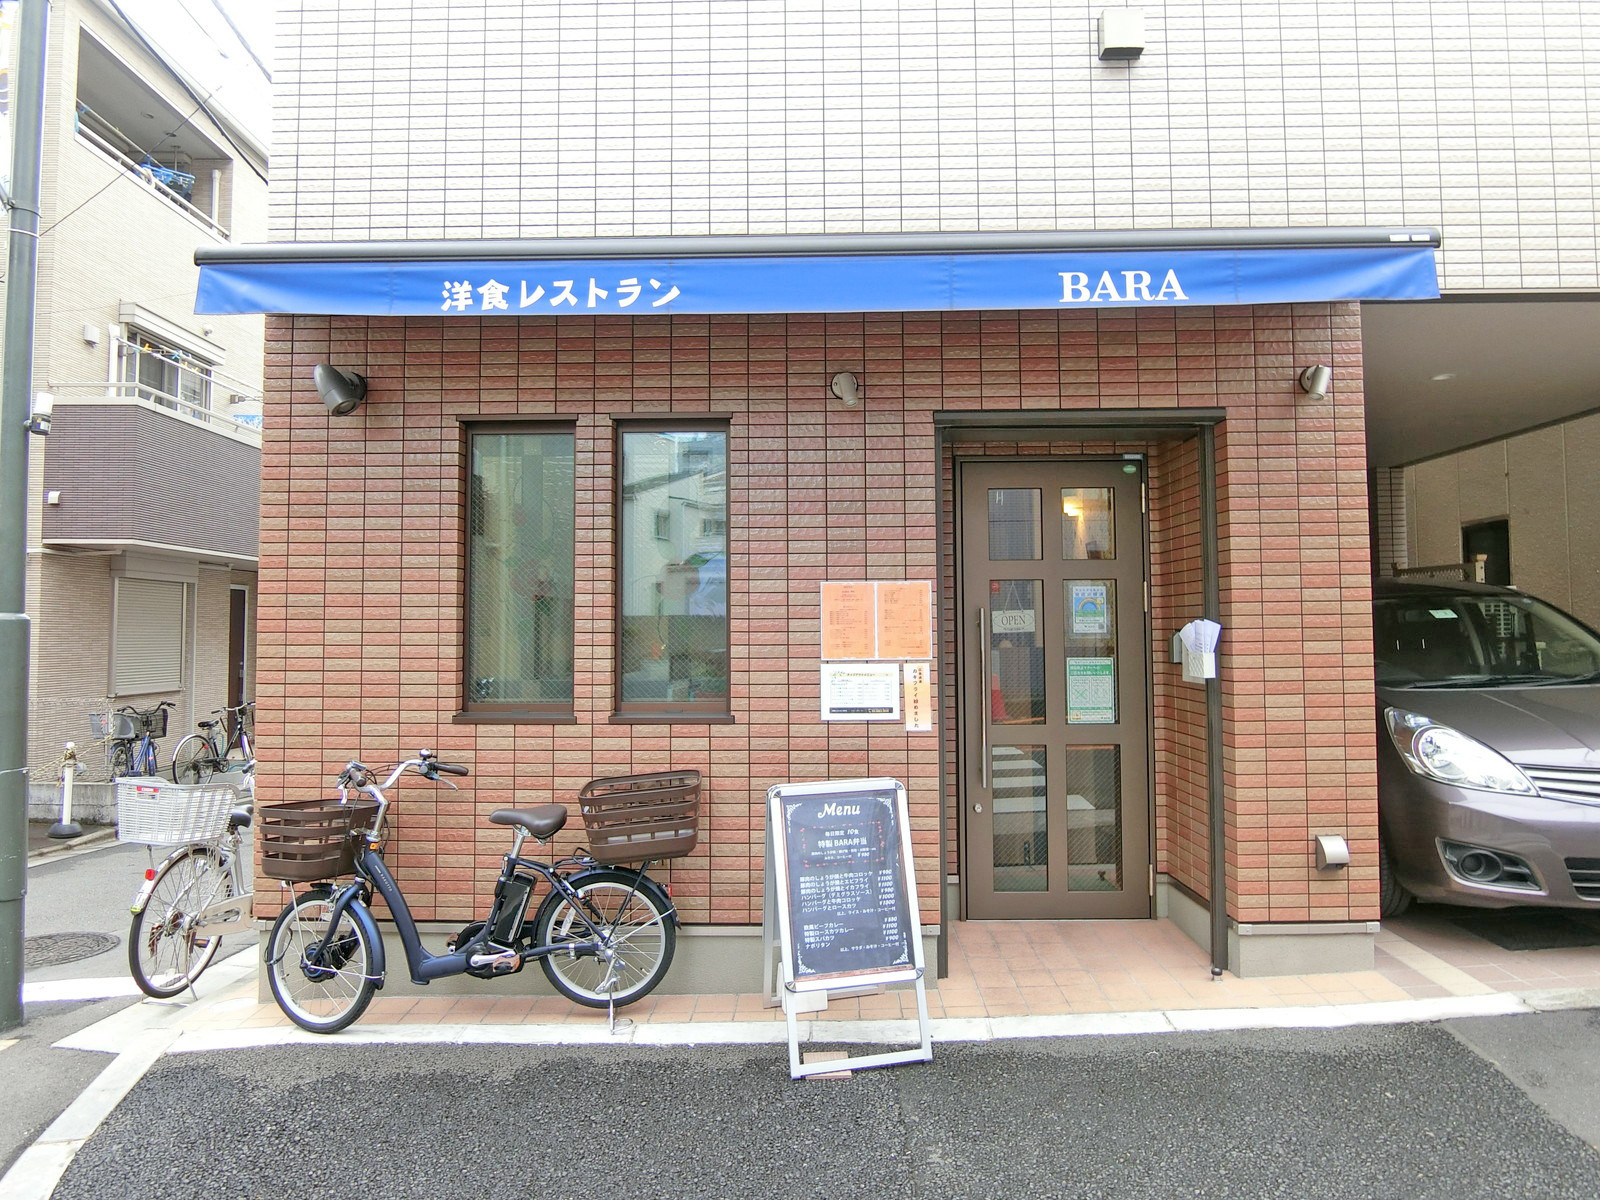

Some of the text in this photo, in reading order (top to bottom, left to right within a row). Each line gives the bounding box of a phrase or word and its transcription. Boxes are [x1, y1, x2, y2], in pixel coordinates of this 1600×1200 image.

[1058, 269, 1189, 302] BARA
[440, 277, 681, 311] 洋食レストラン
[1001, 614, 1027, 626] OPEN
[817, 802, 861, 818] Menu
[805, 942, 831, 950] ナポリタン
